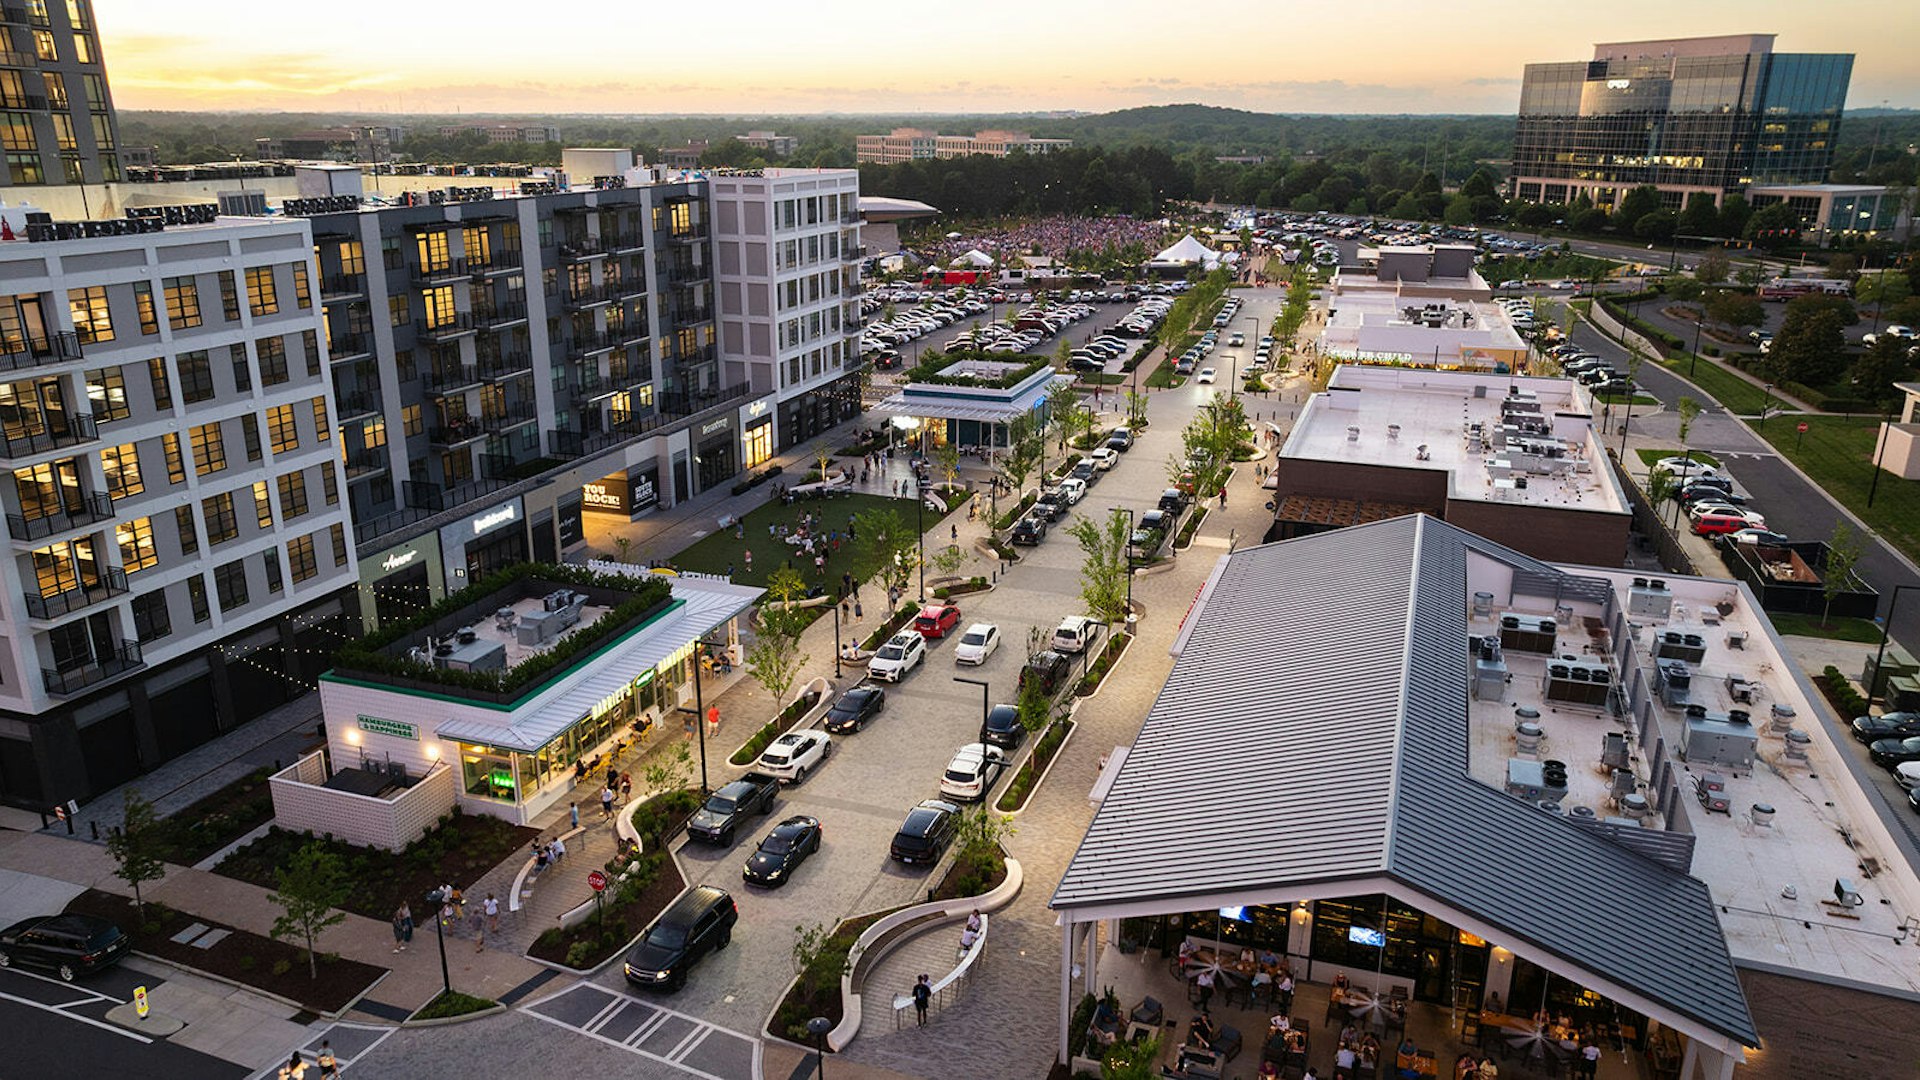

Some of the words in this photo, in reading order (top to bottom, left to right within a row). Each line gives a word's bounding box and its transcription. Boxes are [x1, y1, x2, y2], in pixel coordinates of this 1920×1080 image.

[1376, 351, 1413, 362] CHILD
[583, 484, 606, 495] YOU
[583, 493, 620, 505] ROCK!
[359, 716, 412, 731] HAMBURGERS
[370, 725, 412, 737] HAPPINESS
[589, 876, 605, 887] STOP
